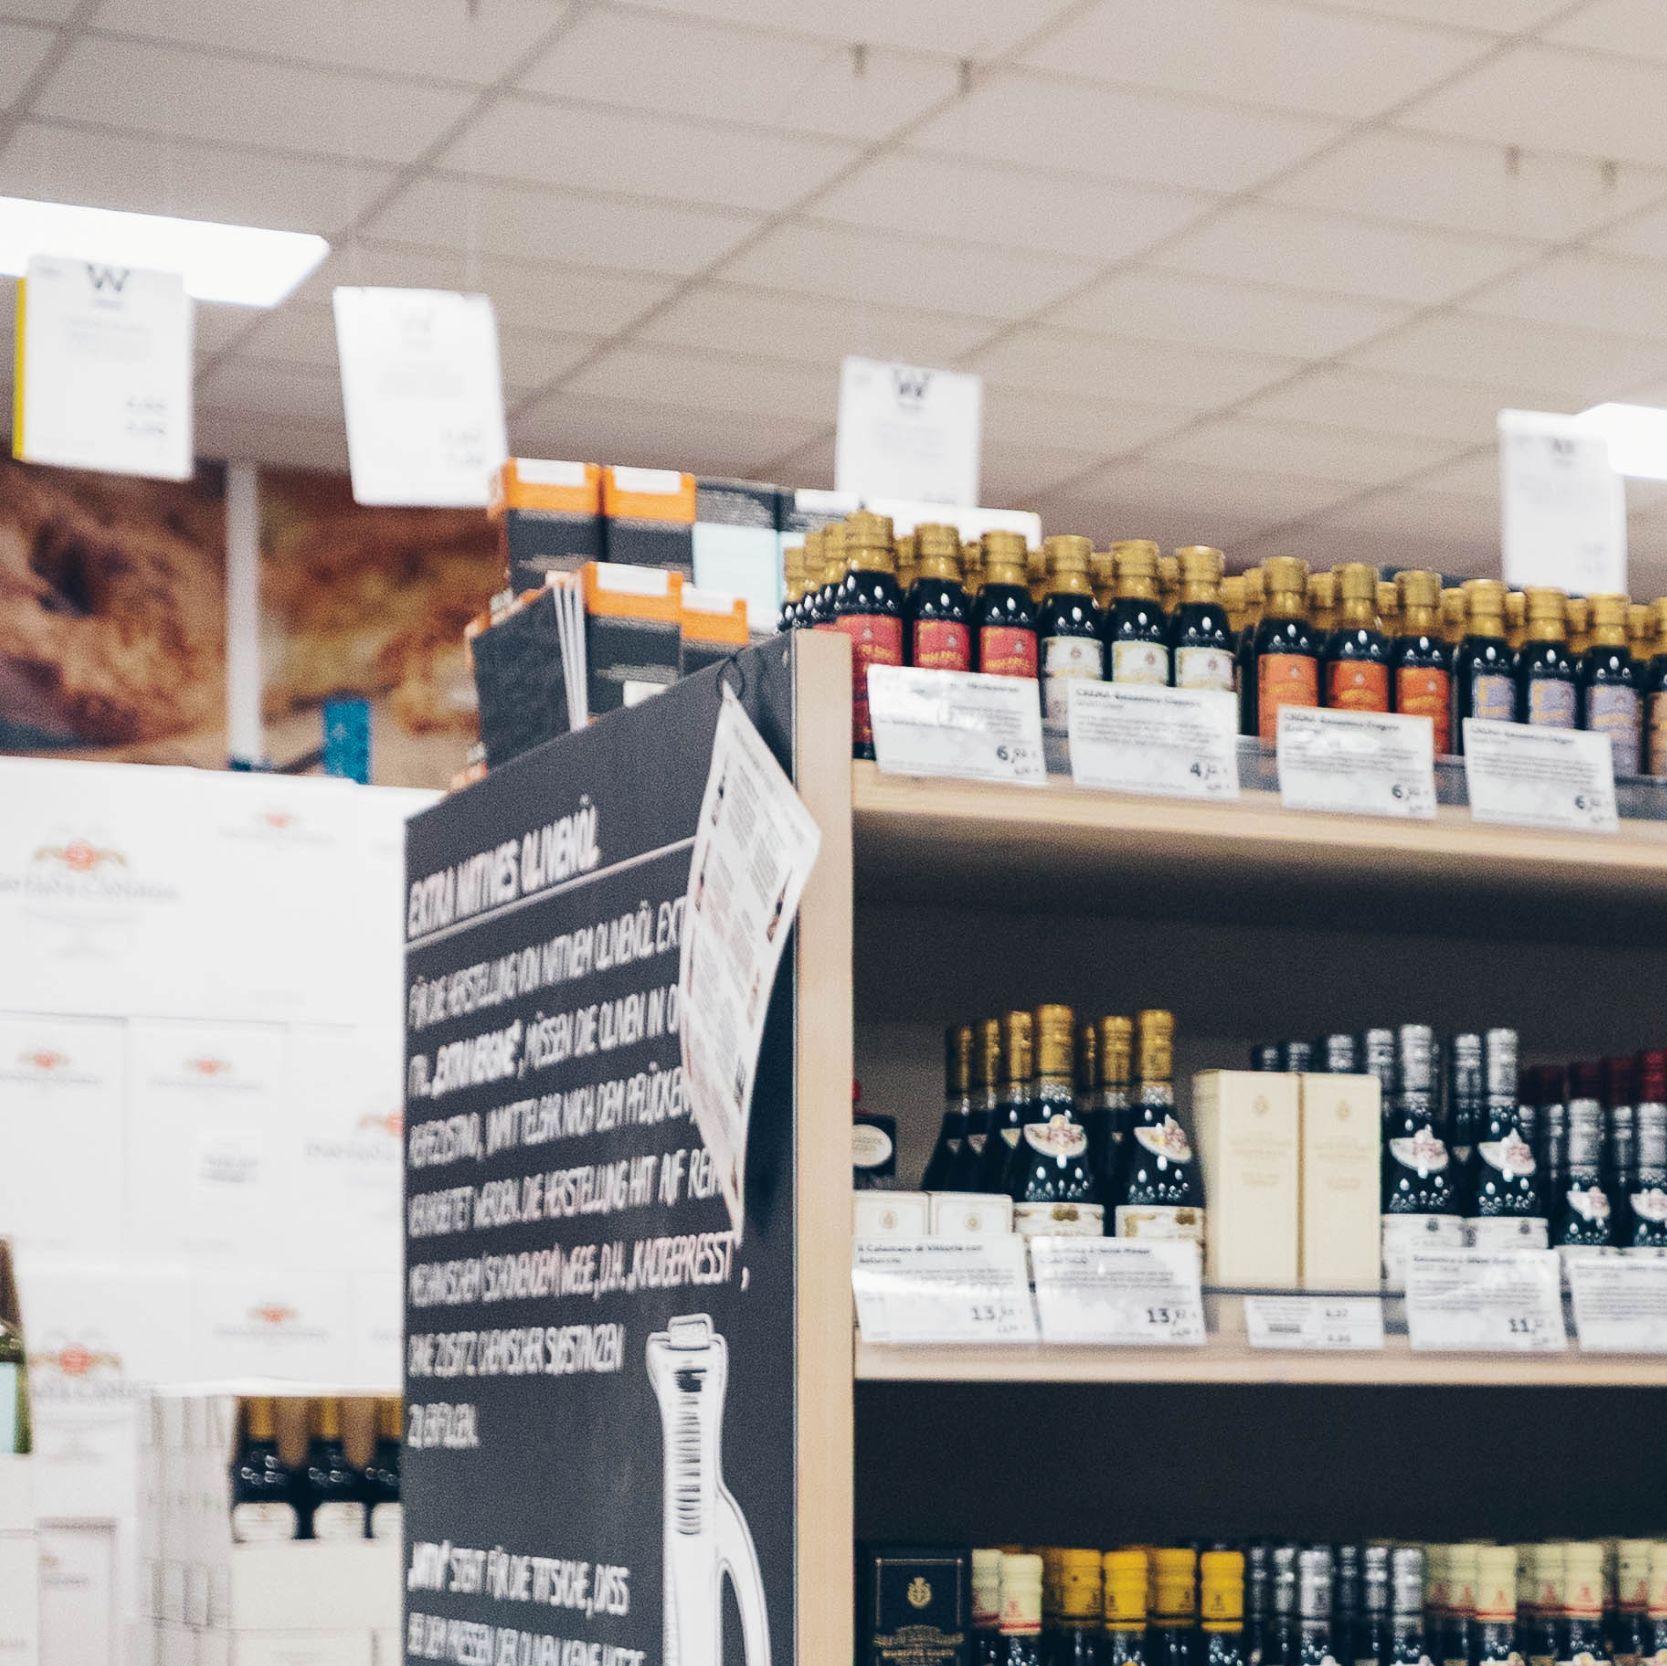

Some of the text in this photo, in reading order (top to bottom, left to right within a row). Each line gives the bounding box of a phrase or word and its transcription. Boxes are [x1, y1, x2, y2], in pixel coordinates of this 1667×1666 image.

[407, 792, 600, 938] EXTRA NATIVES OLIVENÖL
